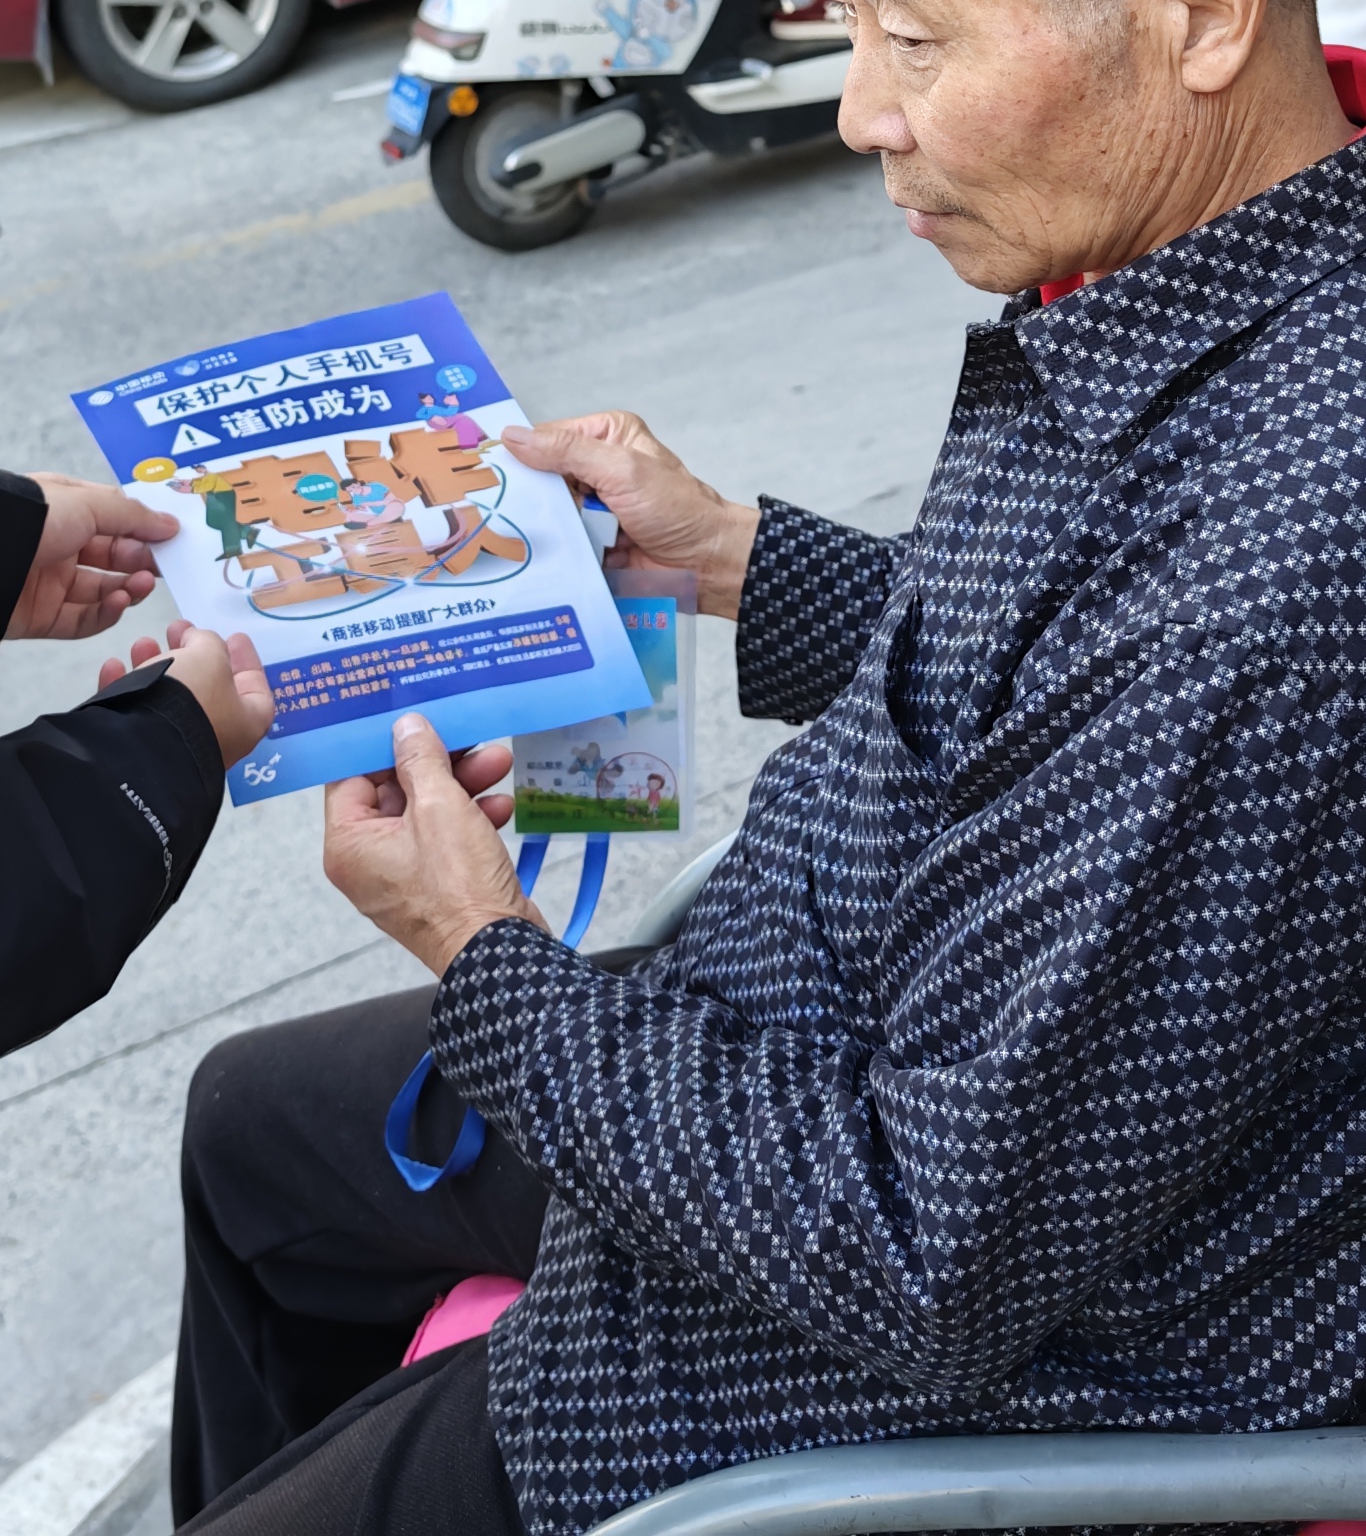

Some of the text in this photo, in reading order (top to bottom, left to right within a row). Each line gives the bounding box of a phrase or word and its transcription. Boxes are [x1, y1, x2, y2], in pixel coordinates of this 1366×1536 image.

[156, 342, 412, 417] 保护个人手机号
[220, 384, 393, 439] 谨防成为
[329, 597, 490, 642] 商洛移动提醒广大群众
